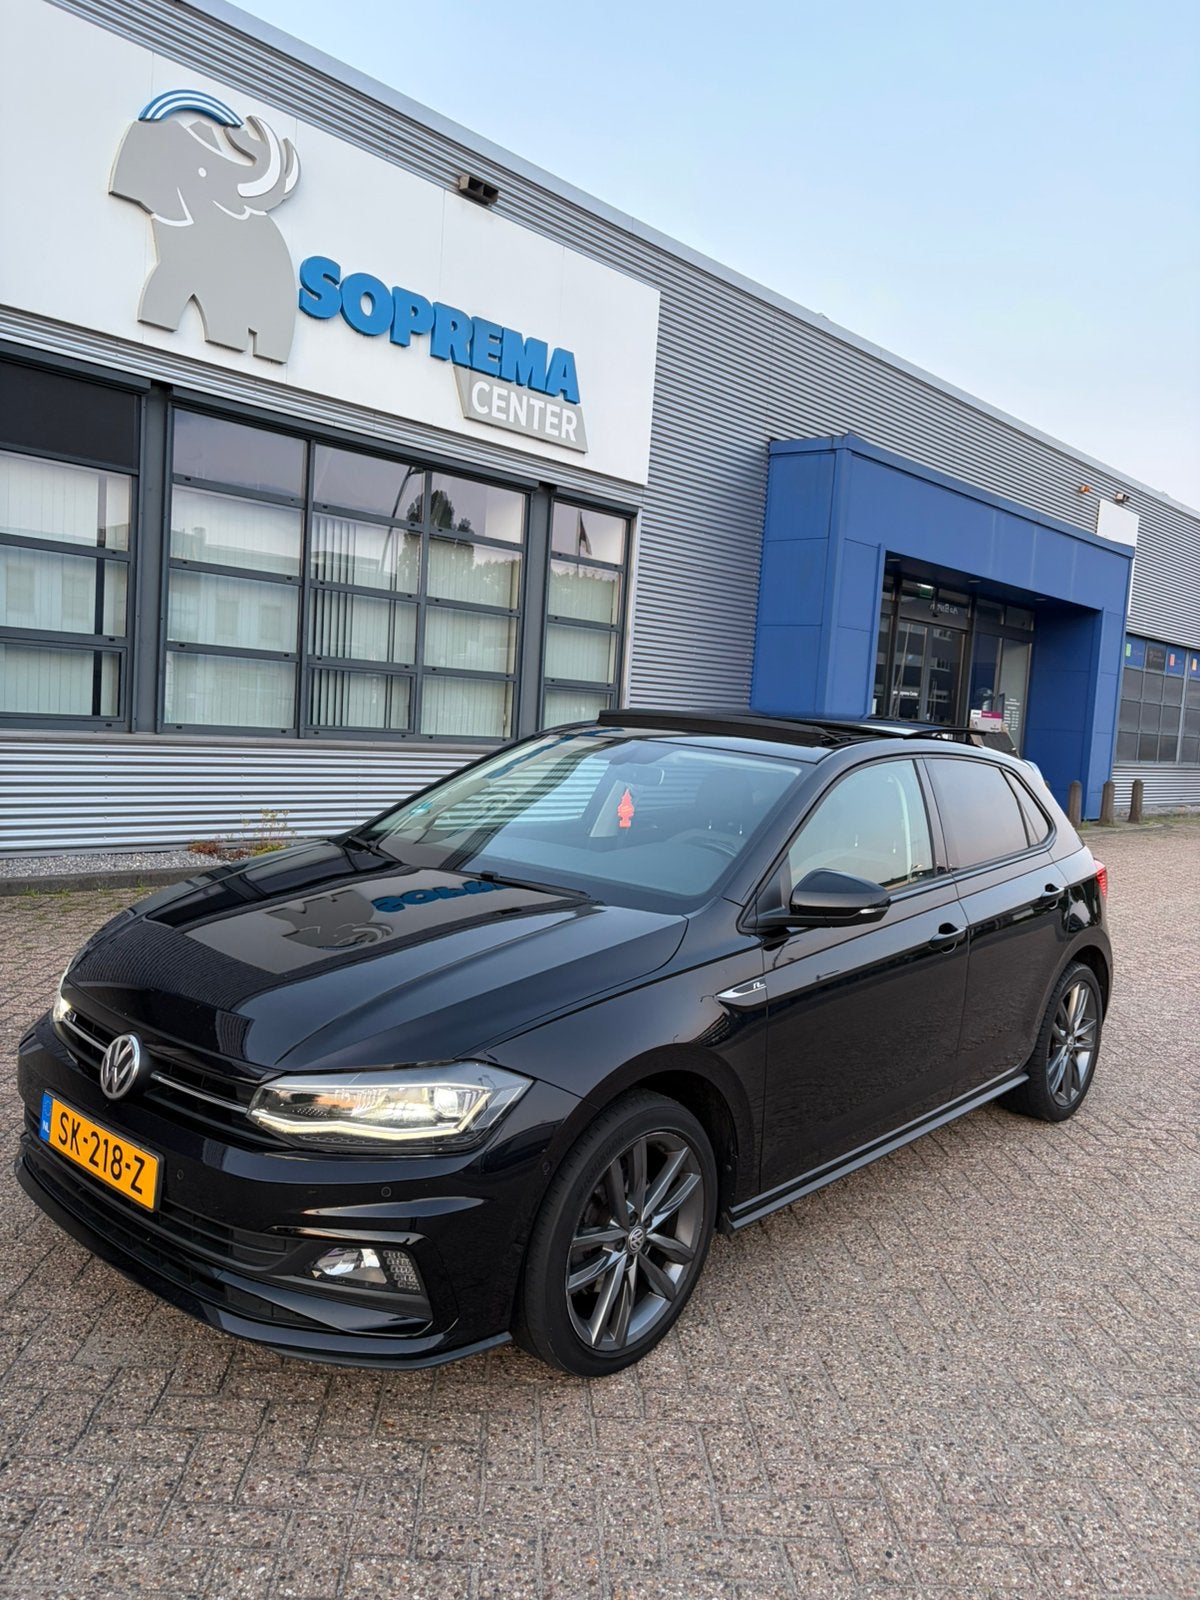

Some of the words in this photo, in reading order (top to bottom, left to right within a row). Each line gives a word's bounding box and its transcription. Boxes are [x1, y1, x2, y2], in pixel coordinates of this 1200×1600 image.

[299, 256, 580, 405] SOPREMA
[471, 380, 578, 442] CENTER
[42, 1120, 50, 1133] NL
[58, 1112, 146, 1195] SK-218-Z
